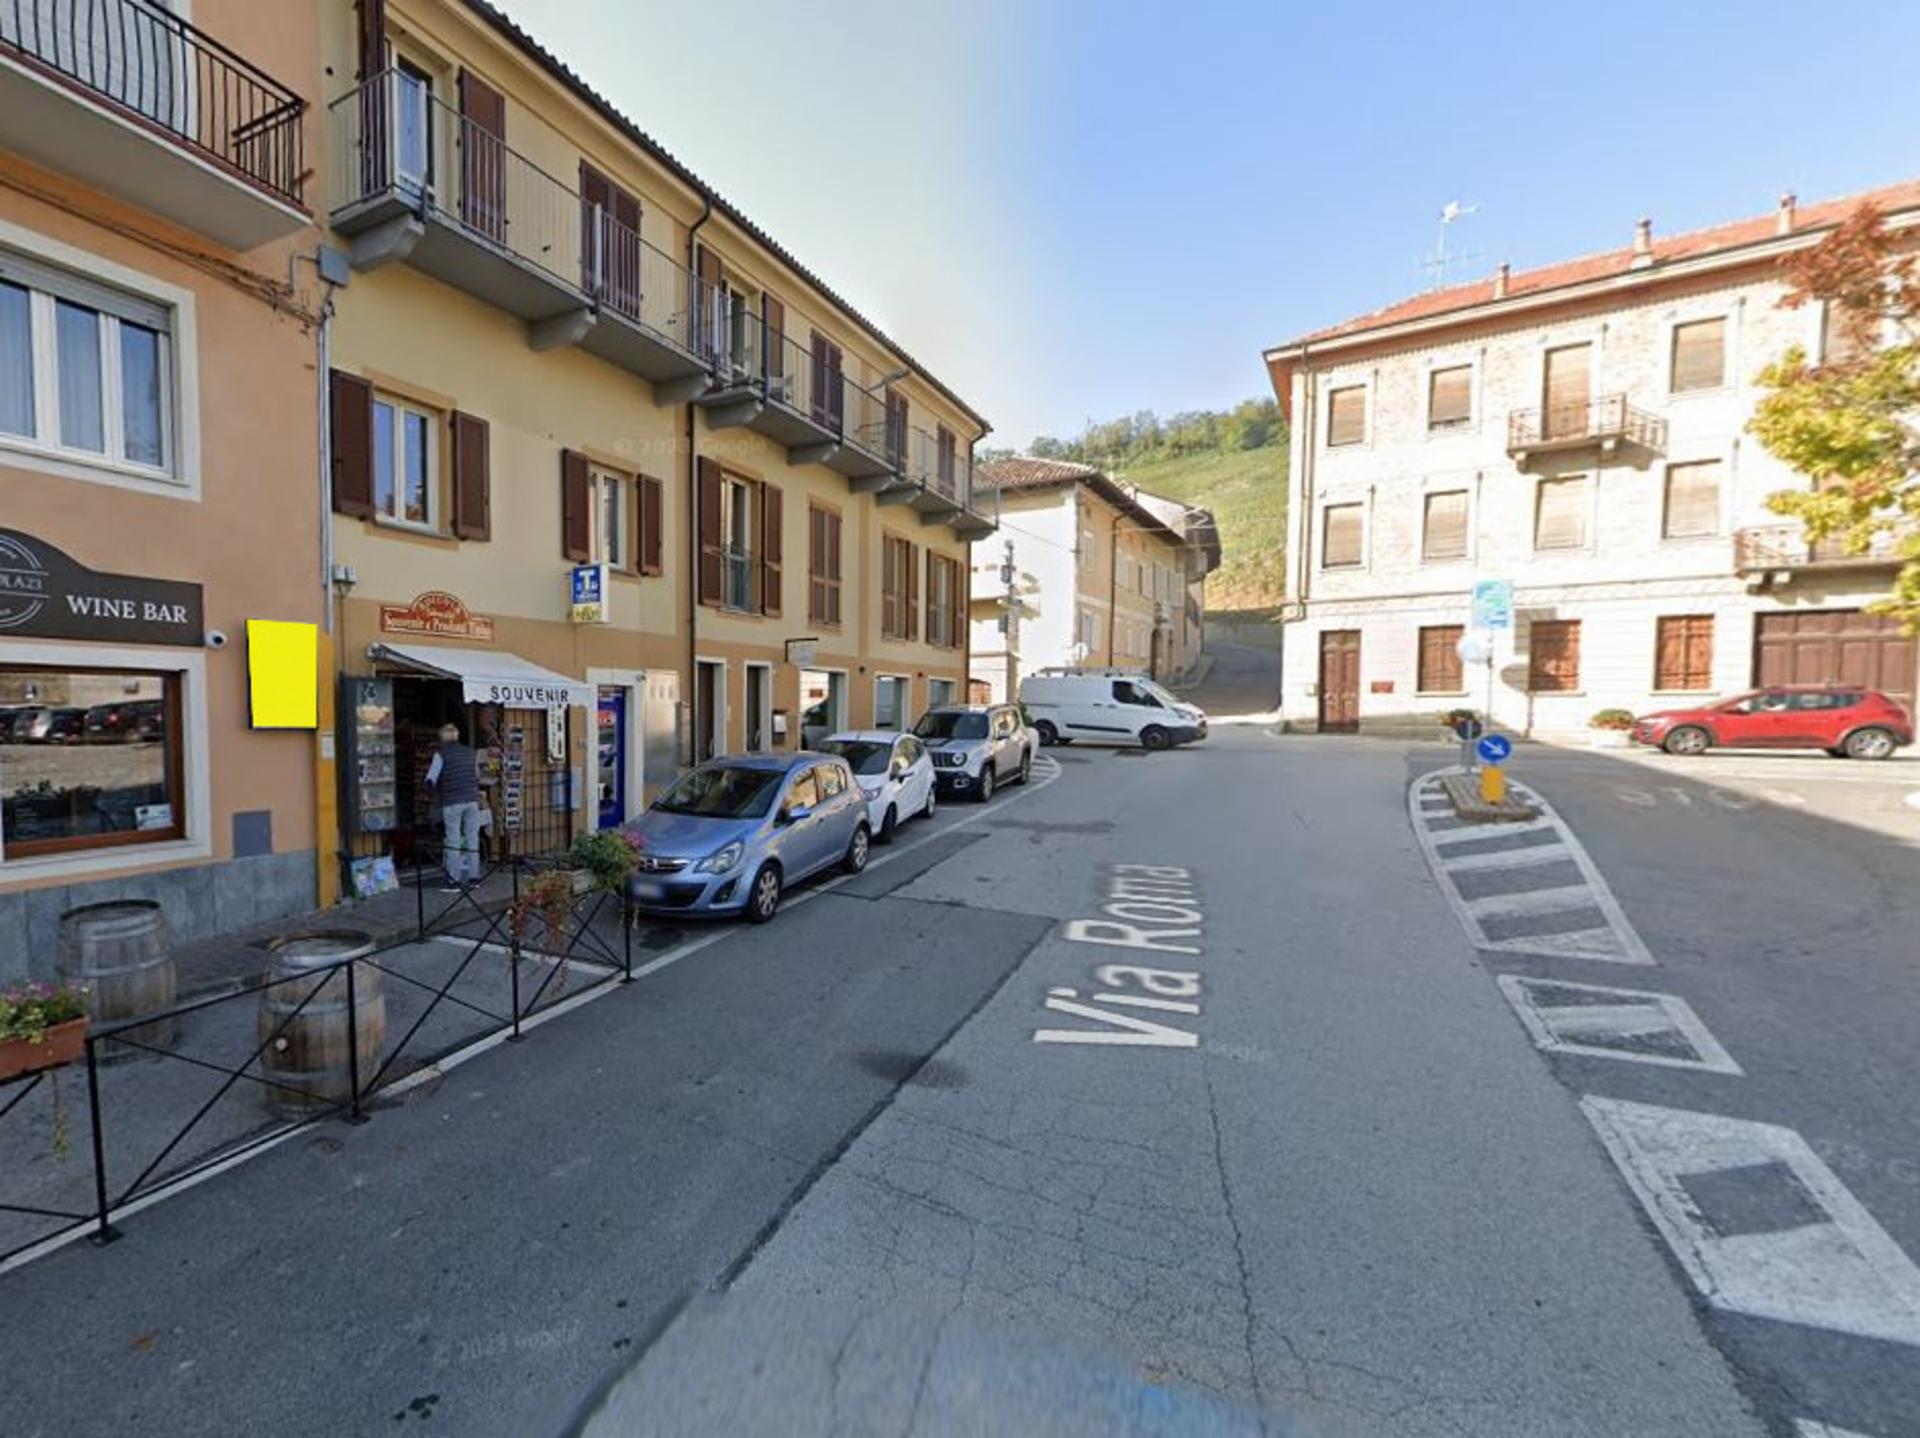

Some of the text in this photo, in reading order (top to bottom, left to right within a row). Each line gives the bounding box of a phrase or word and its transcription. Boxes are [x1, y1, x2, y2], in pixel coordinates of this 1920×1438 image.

[579, 569, 595, 591] T
[66, 595, 188, 624] WINE BAR
[490, 685, 569, 703] SOUVENIR
